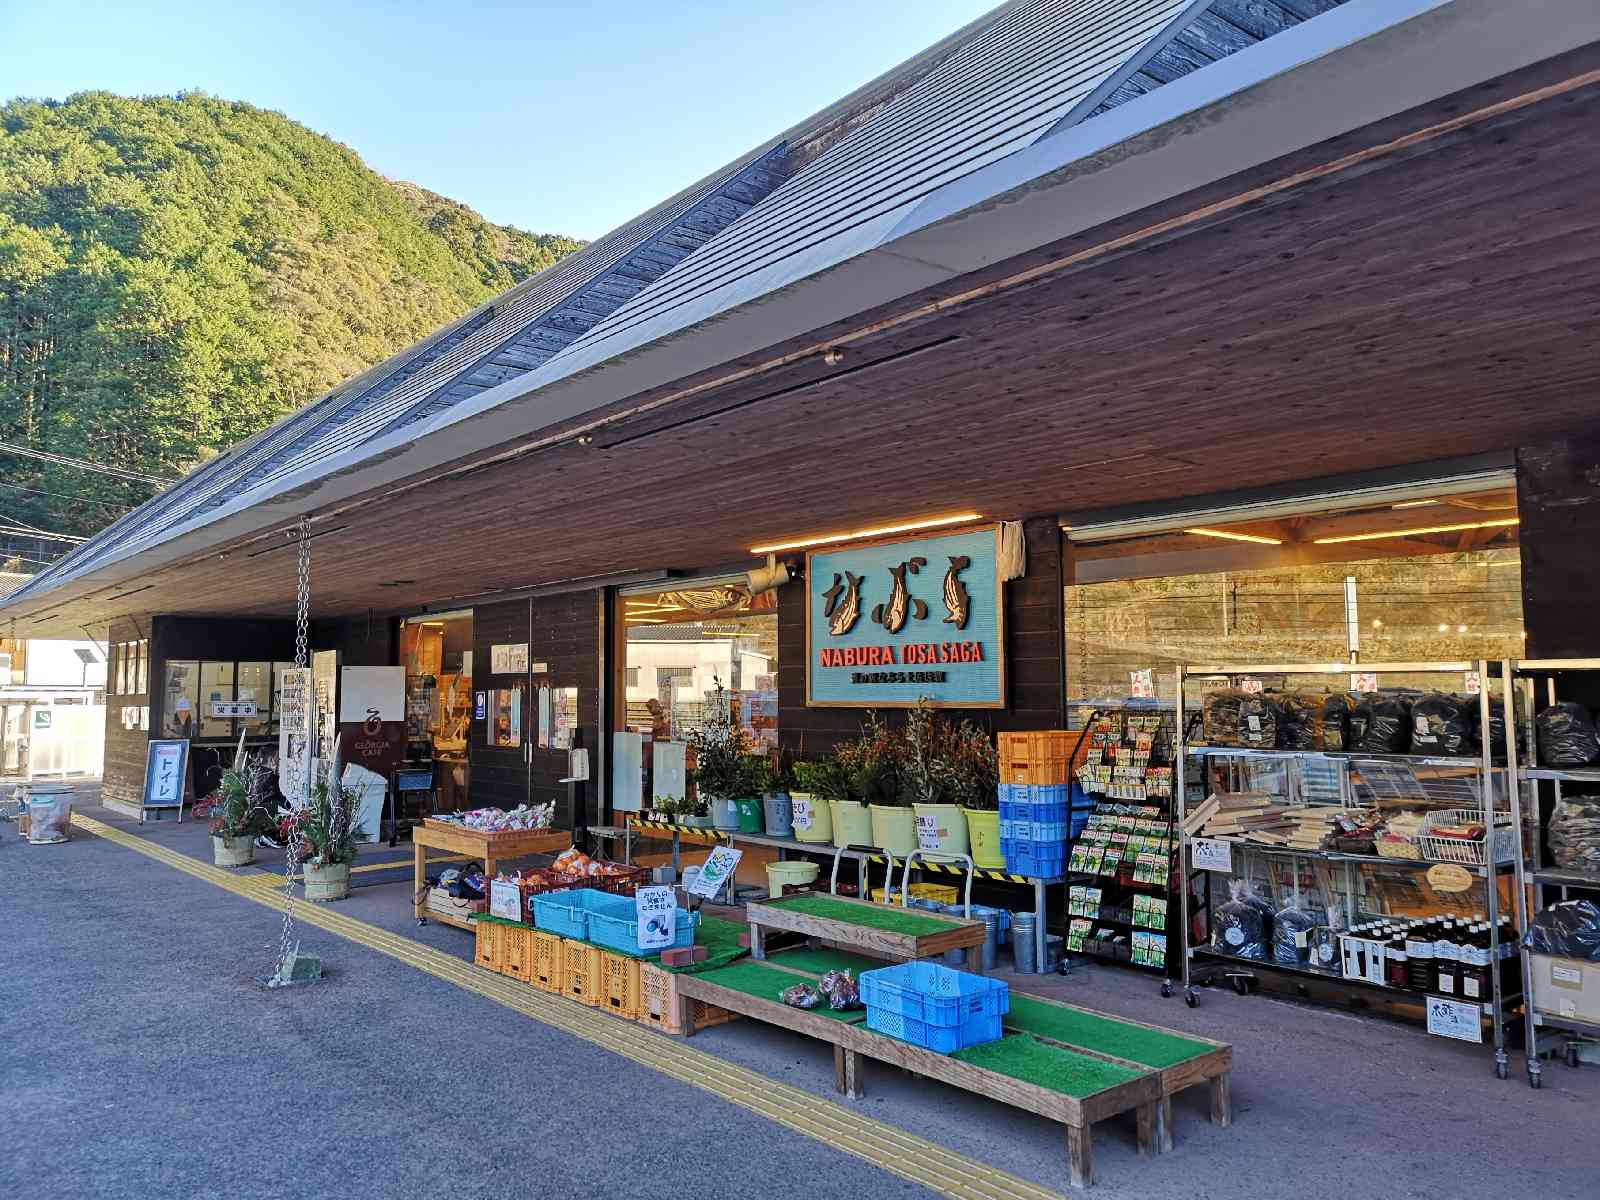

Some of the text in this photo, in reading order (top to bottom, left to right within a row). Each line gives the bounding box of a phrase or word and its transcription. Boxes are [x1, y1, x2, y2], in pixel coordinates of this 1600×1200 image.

[820, 646, 895, 667] NABURA
[939, 641, 983, 664] SAGA
[354, 742, 390, 750] GEORGIA
[160, 758, 173, 797] トイレ
